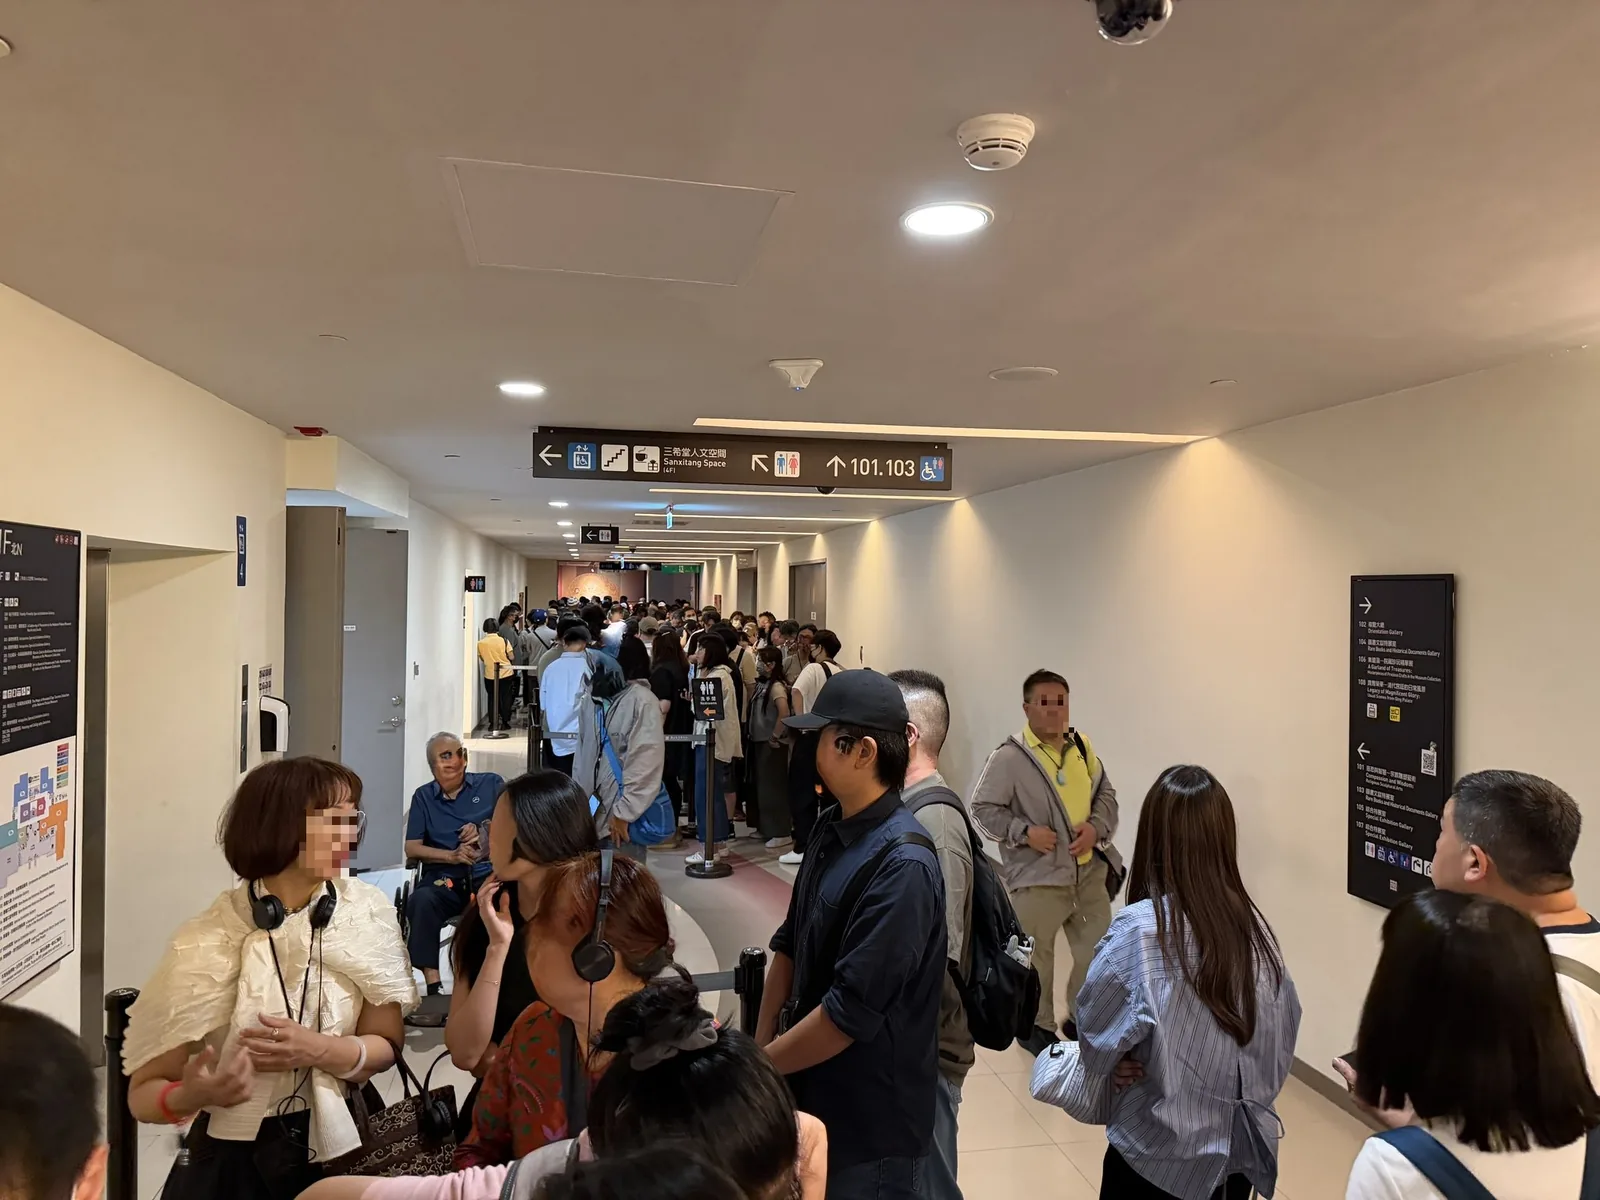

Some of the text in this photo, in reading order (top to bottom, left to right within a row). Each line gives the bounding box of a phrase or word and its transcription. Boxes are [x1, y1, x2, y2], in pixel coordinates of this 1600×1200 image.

[664, 446, 726, 458] 三希堂人文空間
[664, 458, 726, 468] Sanxitang Space
[850, 458, 915, 476] 101.103
[1425, 811, 1438, 820] Gallery
[1380, 816, 1398, 826] Exhibition
[1399, 822, 1413, 832] Gallery
[1365, 830, 1378, 839] Special
[1399, 841, 1413, 850] Gallery
